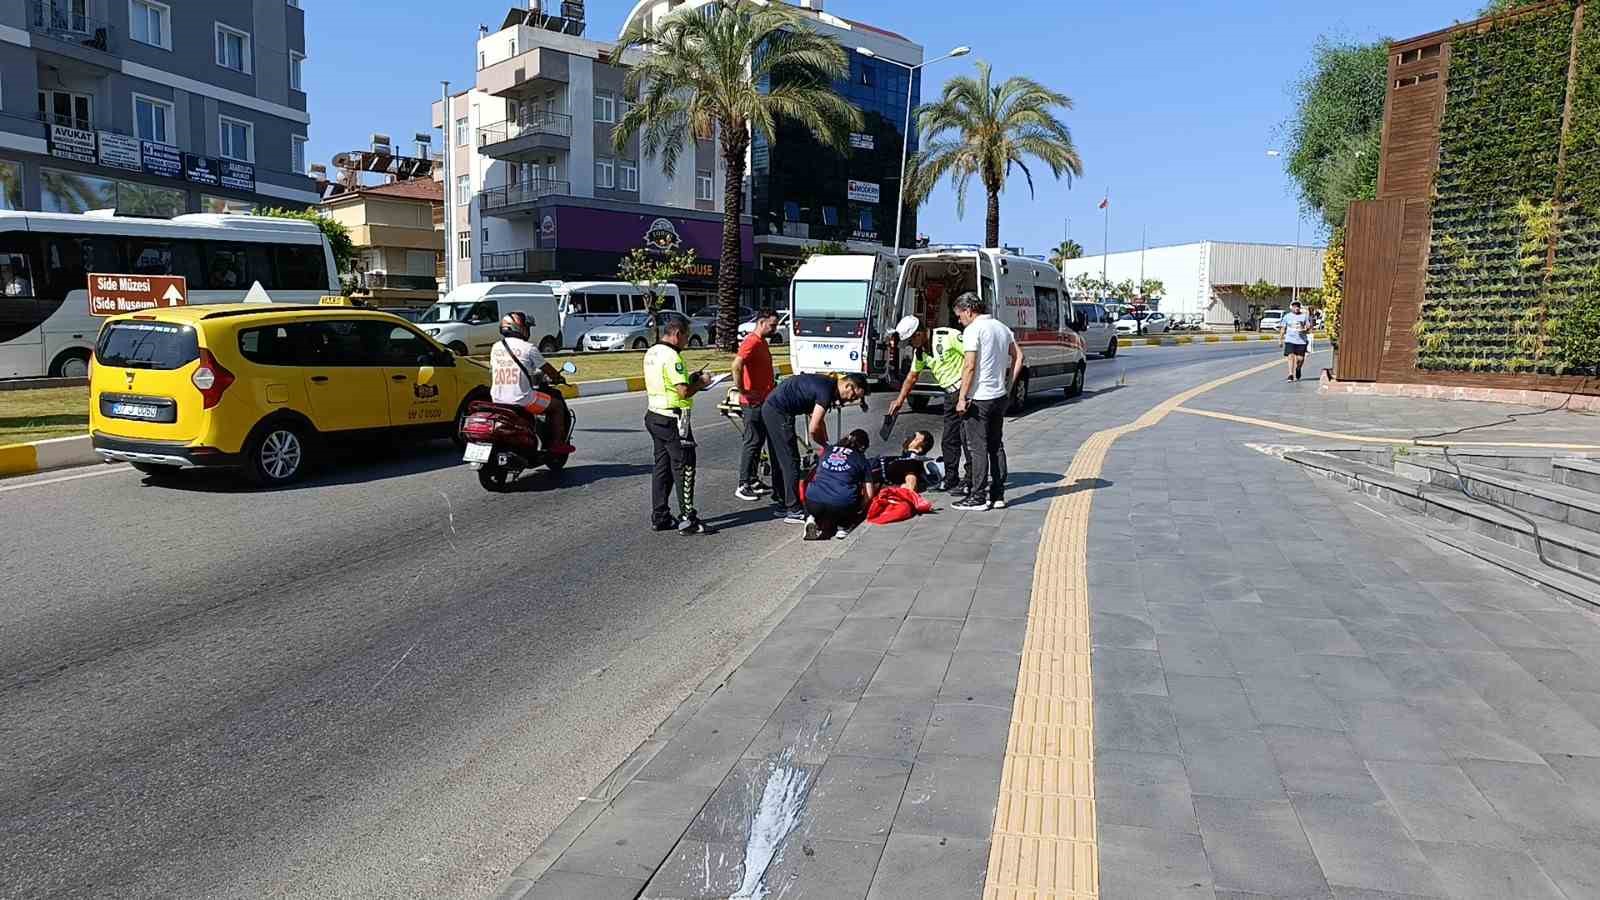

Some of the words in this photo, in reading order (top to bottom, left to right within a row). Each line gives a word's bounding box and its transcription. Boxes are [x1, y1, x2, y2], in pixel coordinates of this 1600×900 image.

[55, 127, 92, 141] AVUKAT
[853, 230, 878, 239] AVUKAT
[97, 277, 118, 291] Side
[120, 278, 151, 292] Müzesi
[93, 296, 116, 312] (Side
[118, 297, 158, 310] Museum)
[1017, 309, 1026, 325] 112
[494, 367, 519, 384] 2025
